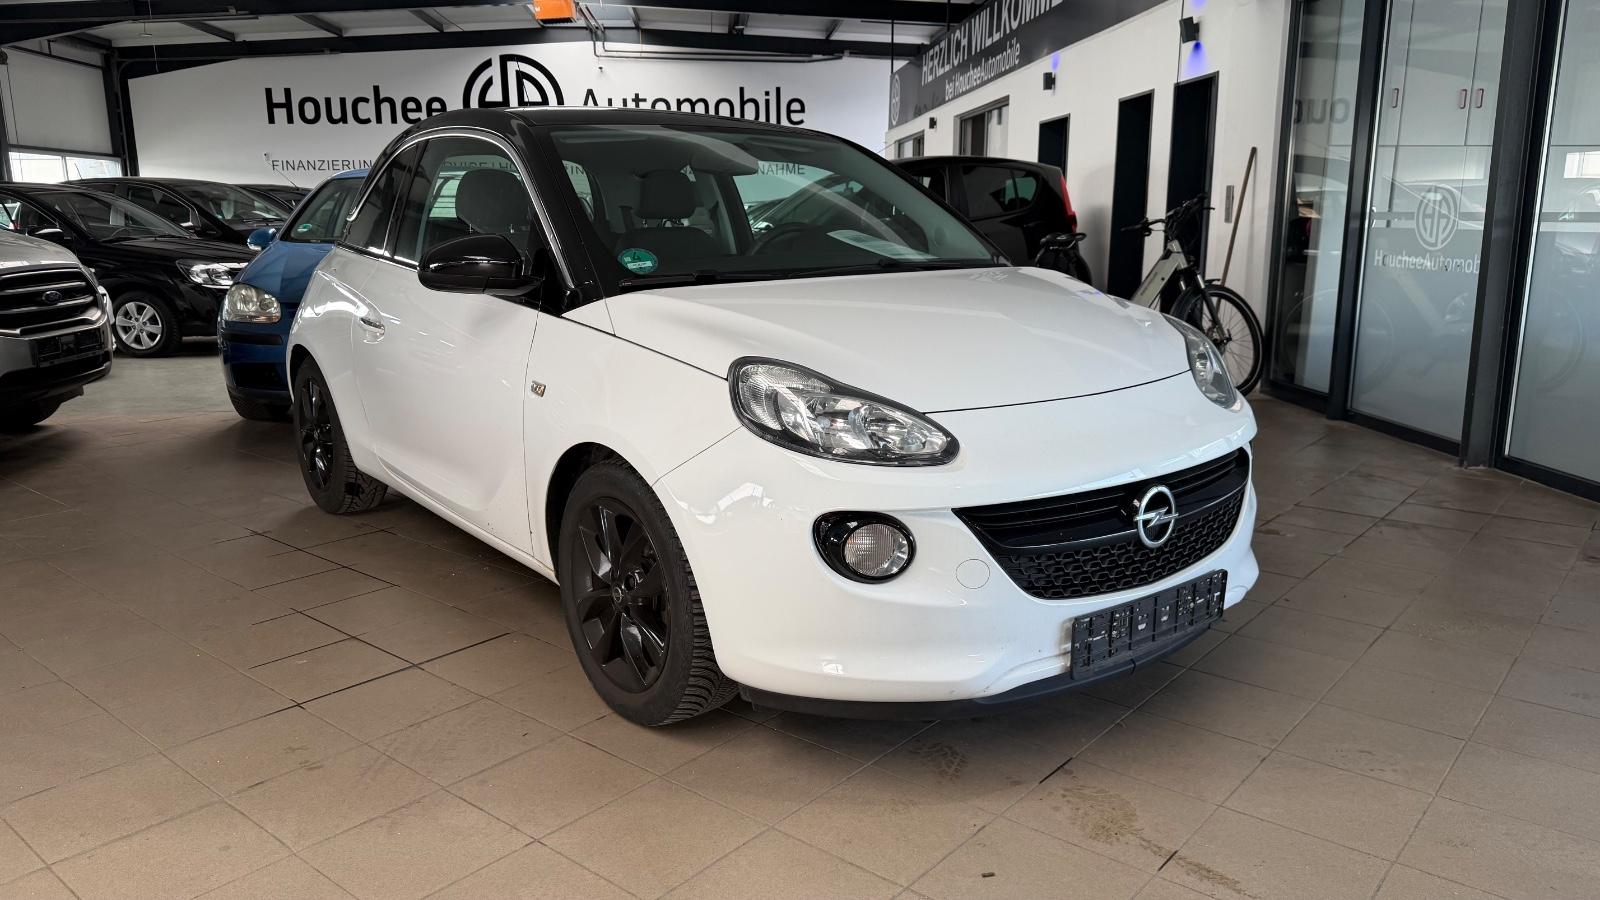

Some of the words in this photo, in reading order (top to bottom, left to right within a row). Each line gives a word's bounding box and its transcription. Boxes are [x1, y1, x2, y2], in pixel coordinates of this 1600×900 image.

[921, 22, 969, 87] HERZLICH
[970, 0, 1062, 56] WILLKOM
[265, 85, 447, 125] Houchee
[271, 159, 373, 171] FINANZIERUN
